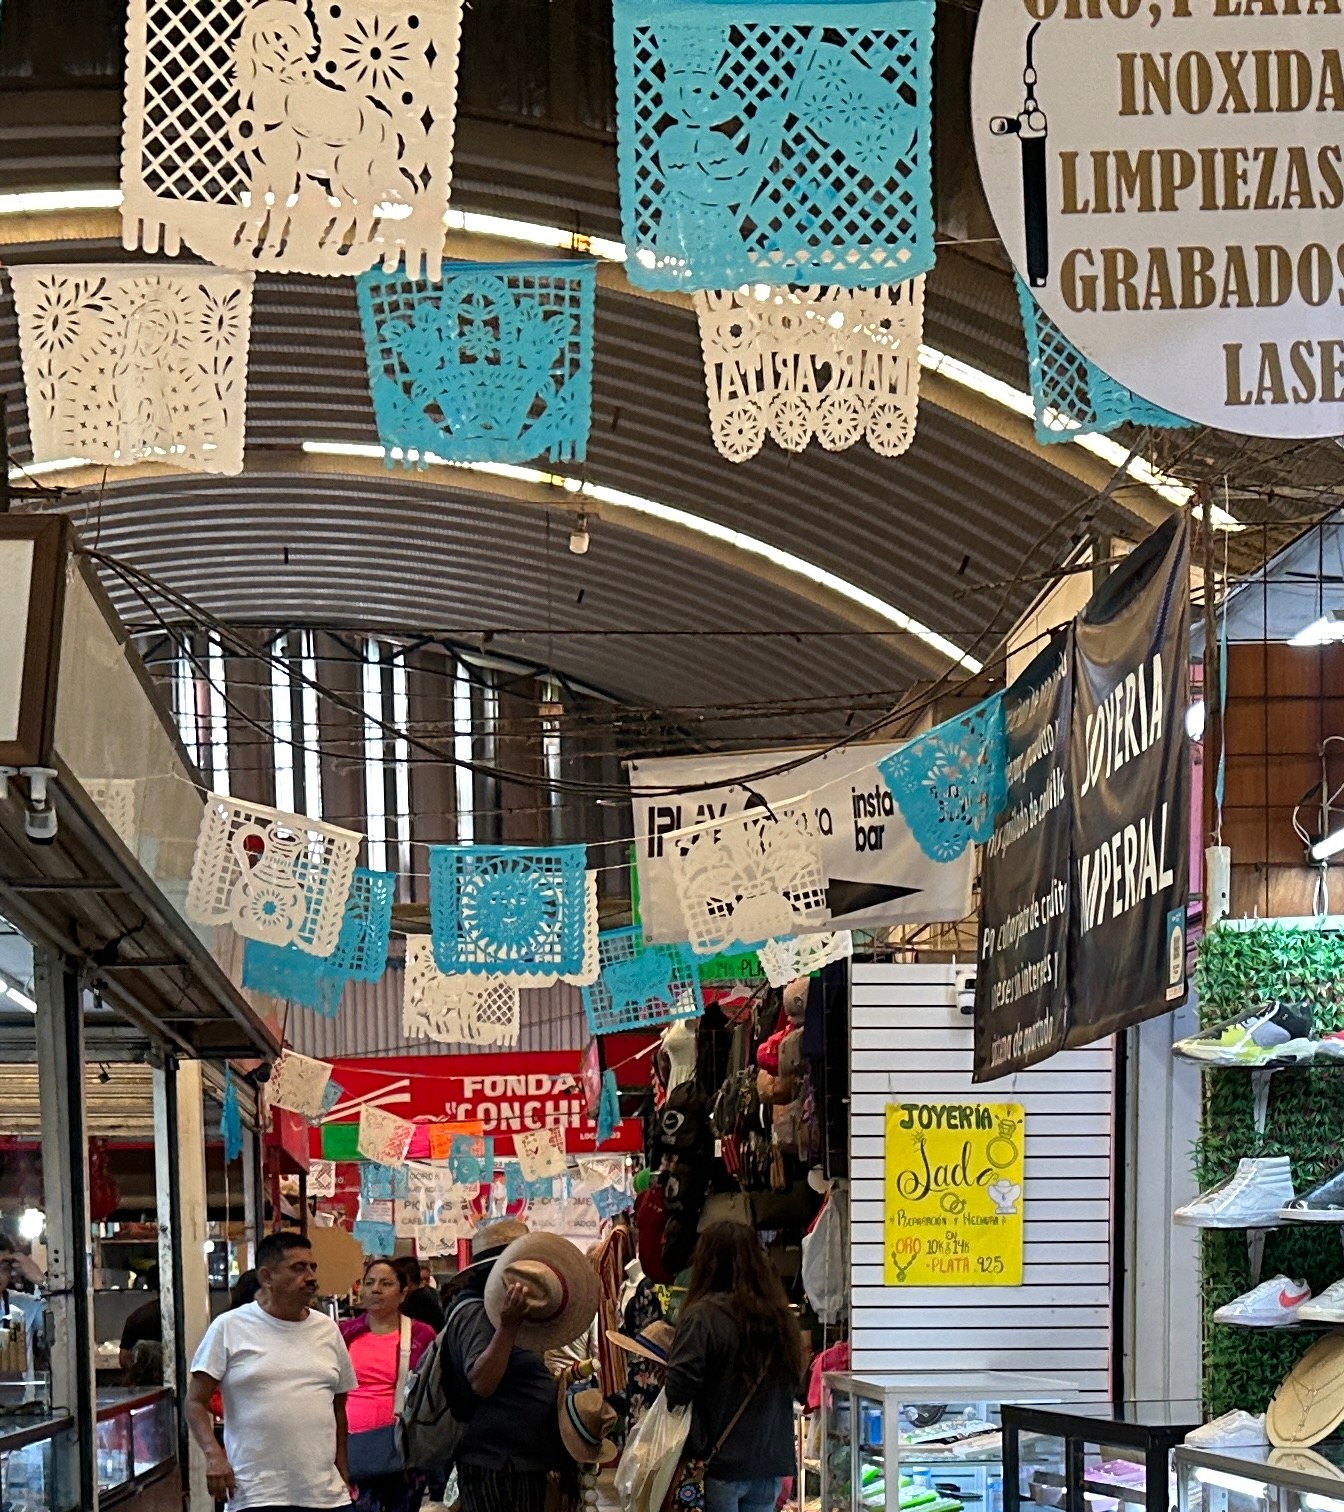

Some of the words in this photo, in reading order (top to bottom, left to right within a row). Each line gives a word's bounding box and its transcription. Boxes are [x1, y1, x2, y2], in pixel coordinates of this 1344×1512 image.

[1080, 652, 1164, 798] JOYERIA
[851, 784, 895, 819] insta
[854, 820, 885, 853] bar
[1077, 802, 1174, 937] IMPERIAL
[463, 1072, 577, 1099] FONDA
